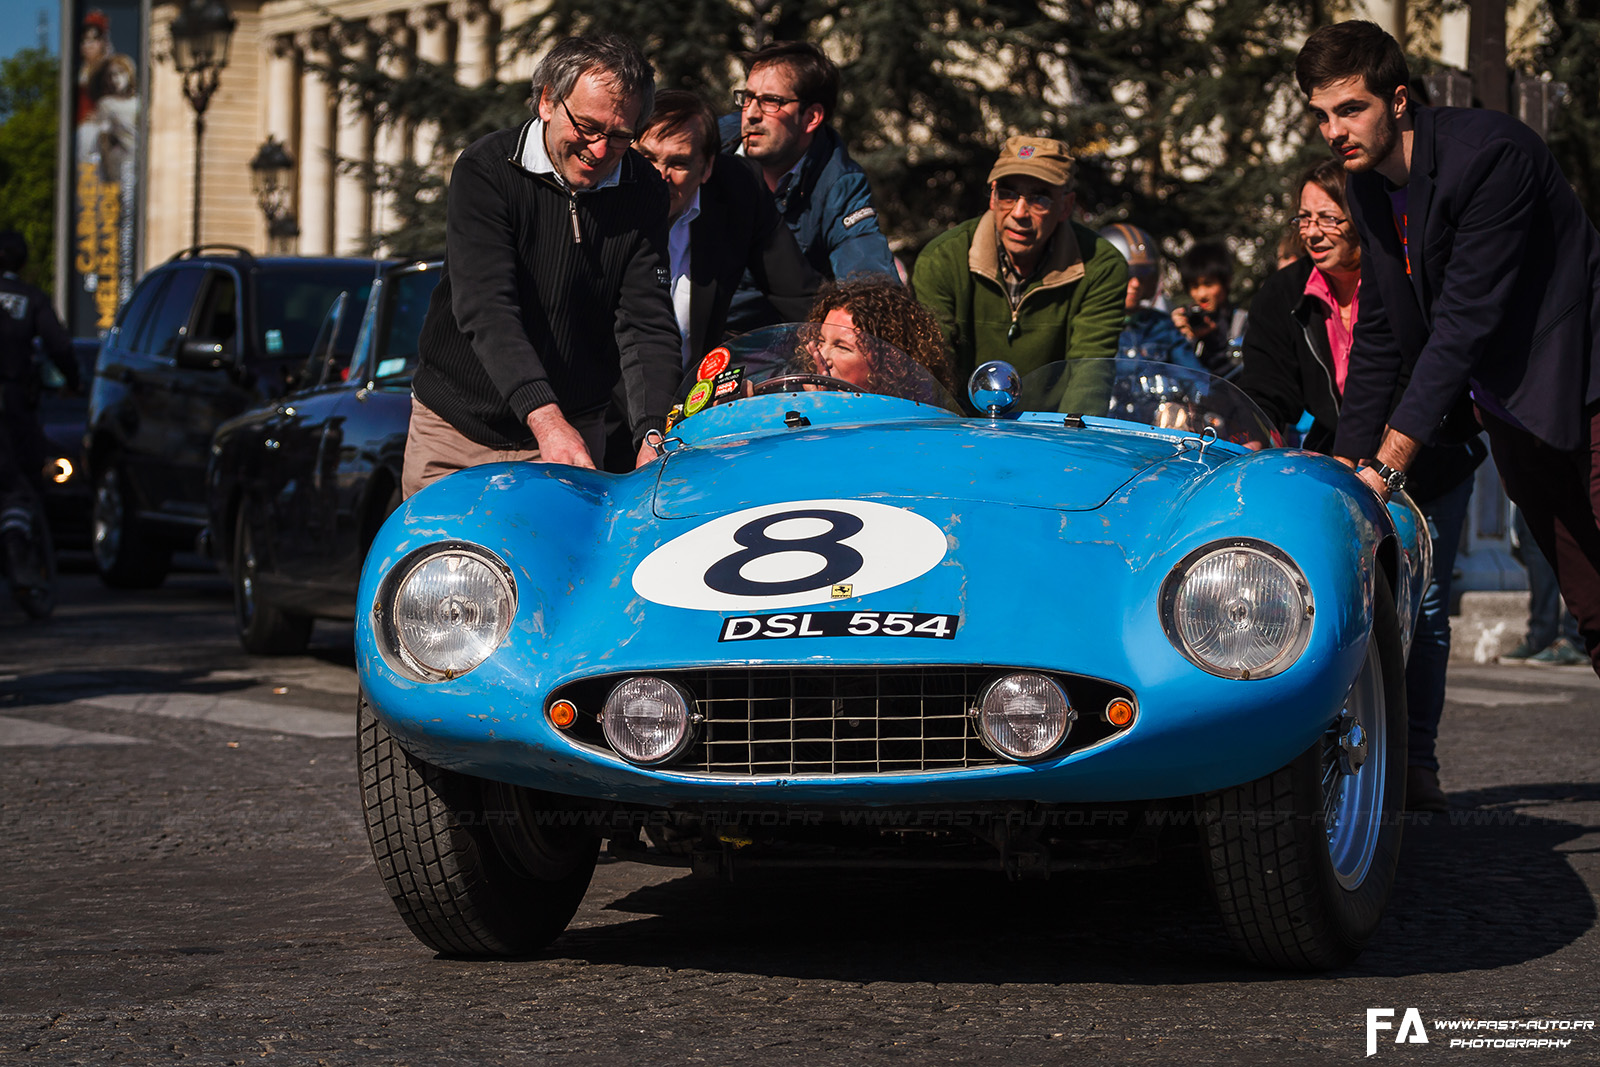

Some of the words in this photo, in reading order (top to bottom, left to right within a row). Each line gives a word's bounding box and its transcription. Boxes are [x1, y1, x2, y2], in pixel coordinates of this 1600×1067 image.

[704, 509, 864, 597] 8
[723, 613, 823, 641] DSL
[847, 612, 950, 637] 554
